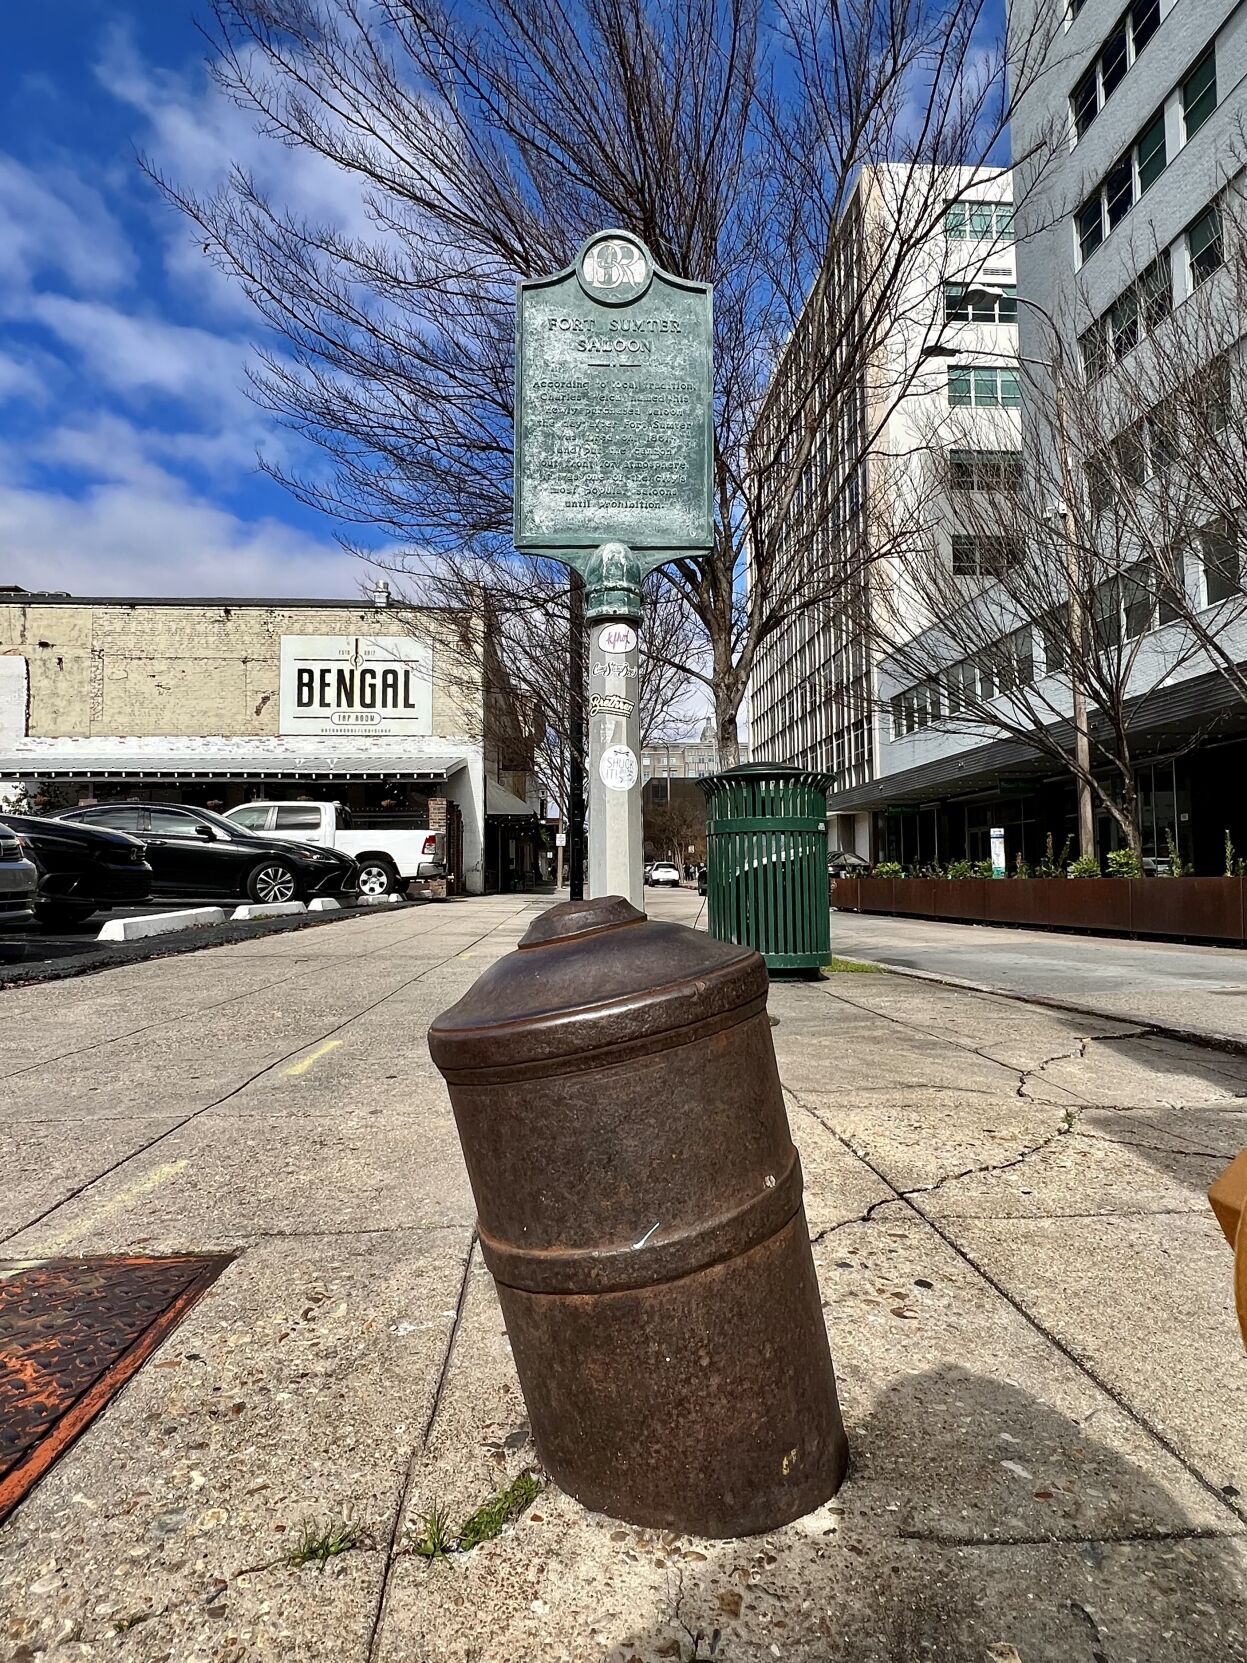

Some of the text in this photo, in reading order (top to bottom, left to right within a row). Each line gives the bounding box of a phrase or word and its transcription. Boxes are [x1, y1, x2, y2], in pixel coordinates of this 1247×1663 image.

[548, 318, 682, 333] FORT SUMTER
[577, 339, 652, 353] SALOON
[532, 380, 589, 391] According
[540, 392, 582, 402] Charles
[652, 420, 692, 430] Sumter
[564, 500, 590, 508] until
[297, 668, 415, 709] BENGAL
[590, 693, 635, 717] Brethren
[338, 714, 375, 722] TAP ROOM
